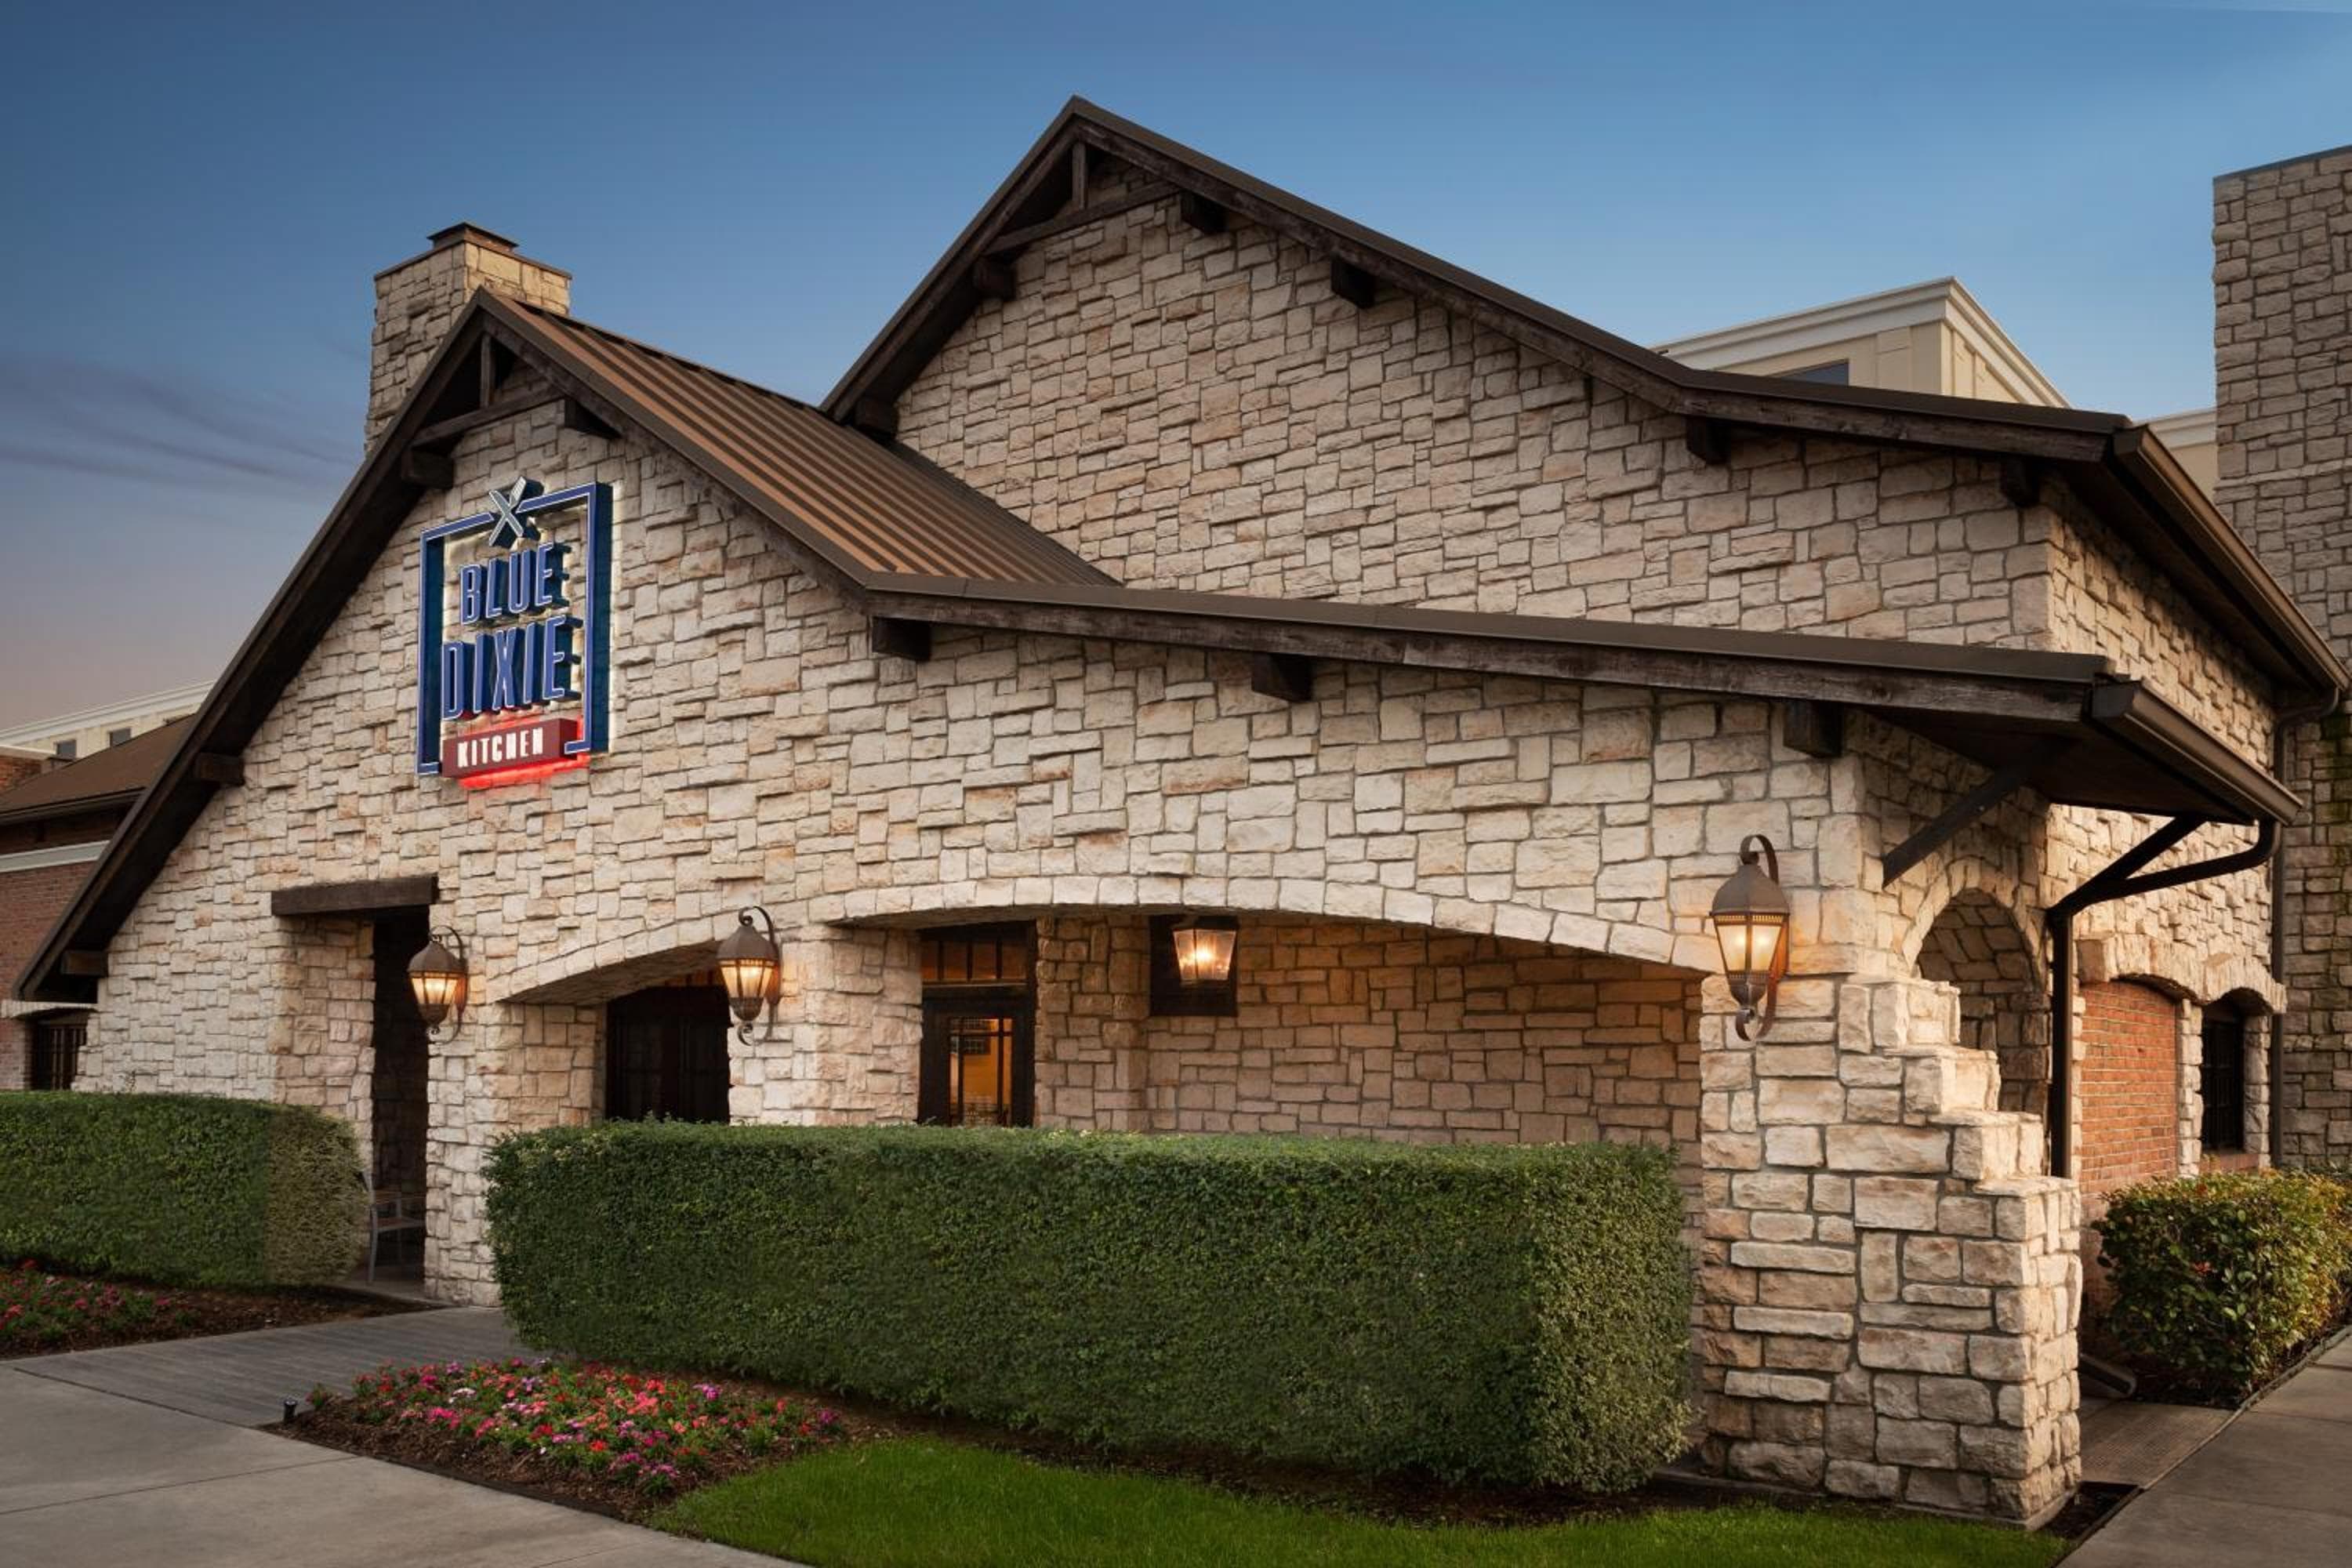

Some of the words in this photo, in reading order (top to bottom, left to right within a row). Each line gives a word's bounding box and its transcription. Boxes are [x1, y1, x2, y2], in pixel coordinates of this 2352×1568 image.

[460, 543, 554, 626] BLUE
[441, 615, 566, 720] DIXIE
[457, 728, 543, 768] KITCHEN
